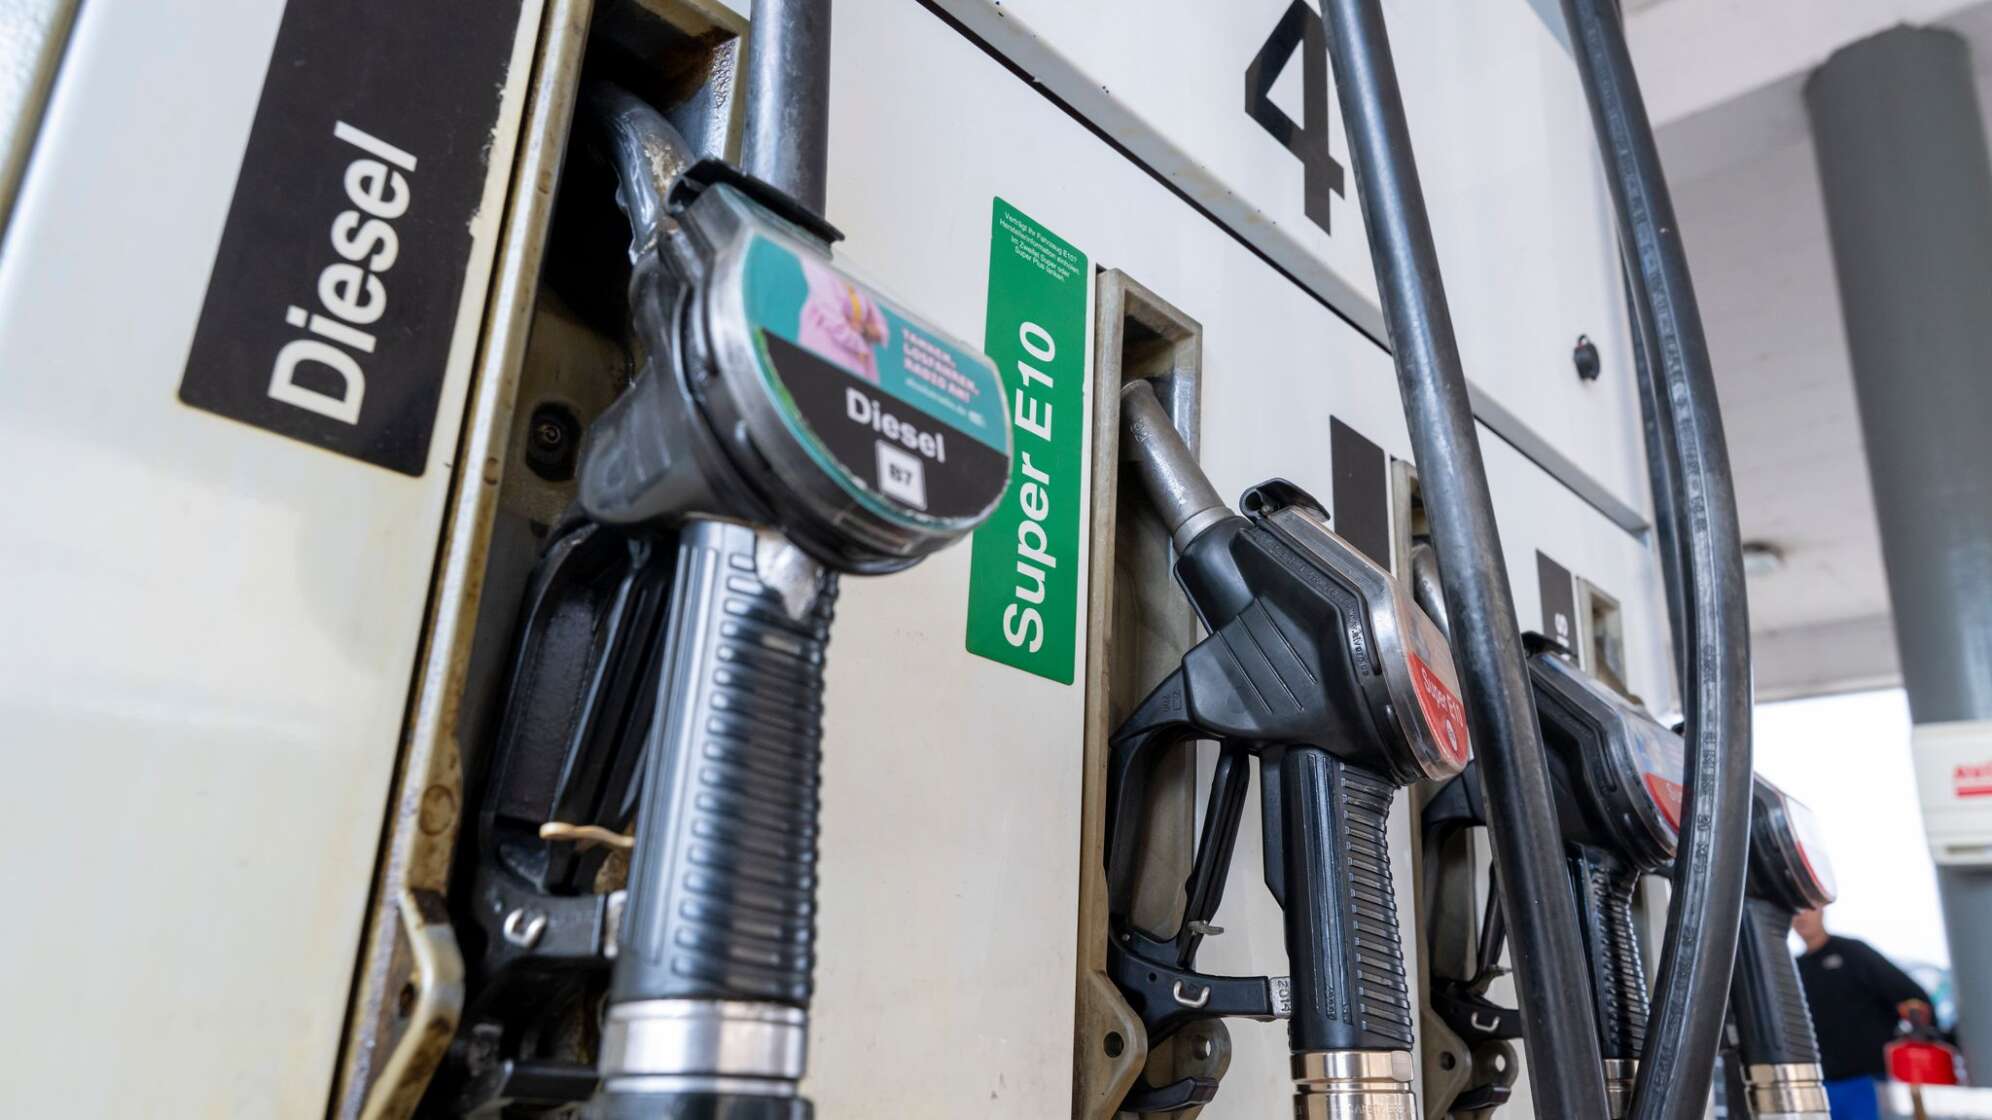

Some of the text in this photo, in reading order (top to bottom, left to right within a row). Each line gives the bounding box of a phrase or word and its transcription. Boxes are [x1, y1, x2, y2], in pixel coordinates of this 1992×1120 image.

[1245, 0, 1345, 236] 4
[267, 120, 418, 425] Diesel
[846, 386, 946, 463] Diesel
[889, 463, 912, 486] B7
[1003, 321, 1057, 654] Super E10
